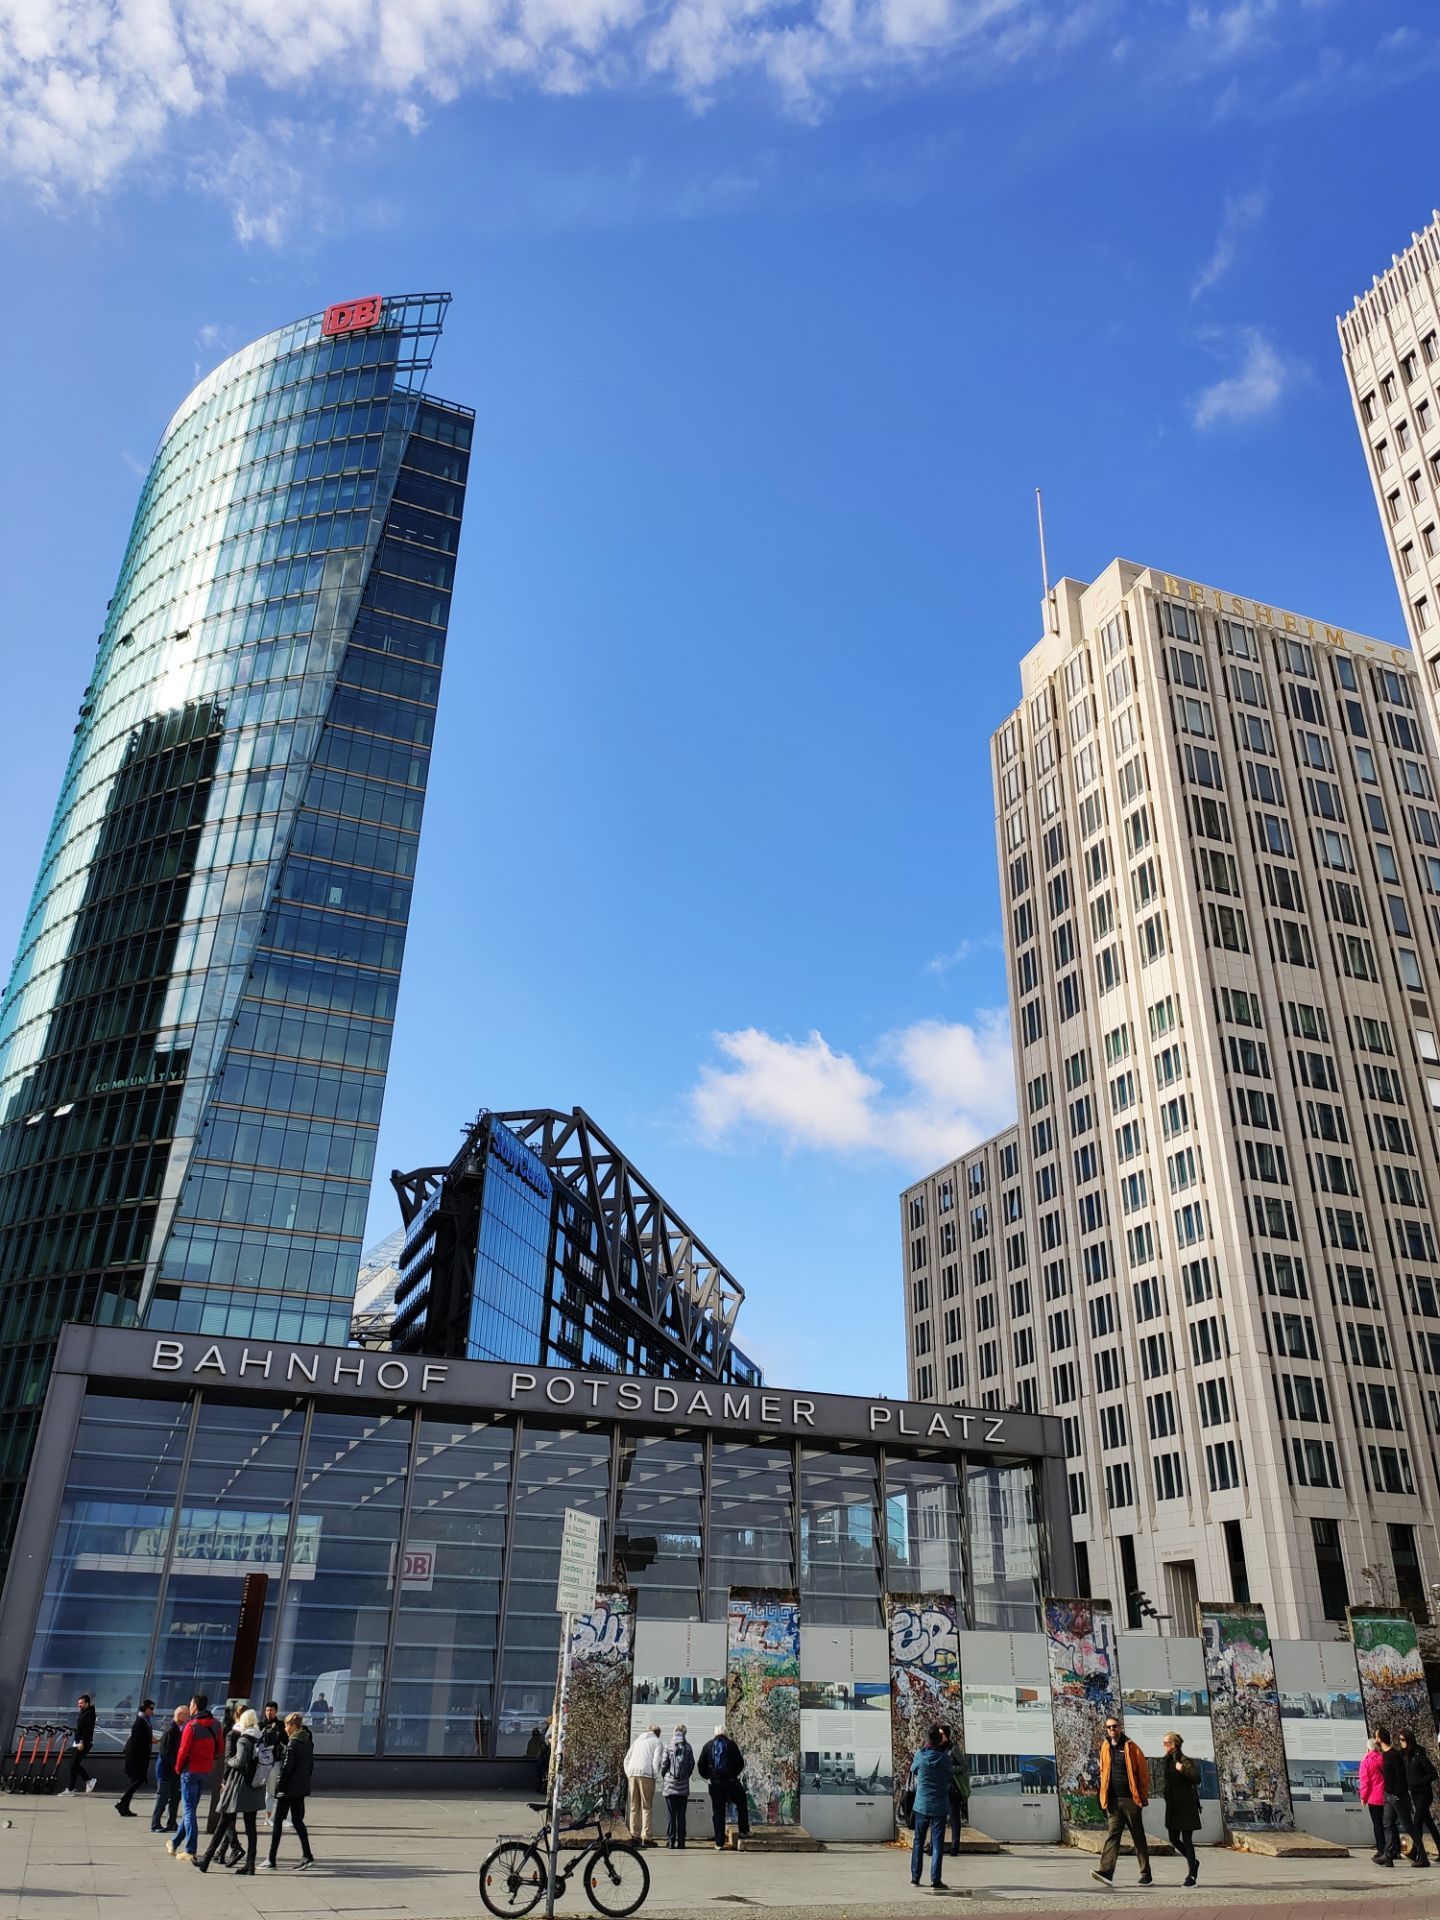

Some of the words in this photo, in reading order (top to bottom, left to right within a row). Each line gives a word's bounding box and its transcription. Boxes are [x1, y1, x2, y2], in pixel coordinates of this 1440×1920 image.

[329, 299, 376, 331] DB
[1163, 575, 1346, 649] BEISHEIM
[151, 1339, 449, 1392] BAHNHOF
[510, 1372, 817, 1427] POTSDAMER
[870, 1405, 1007, 1444] PLATZ
[404, 1556, 428, 1575] DB
